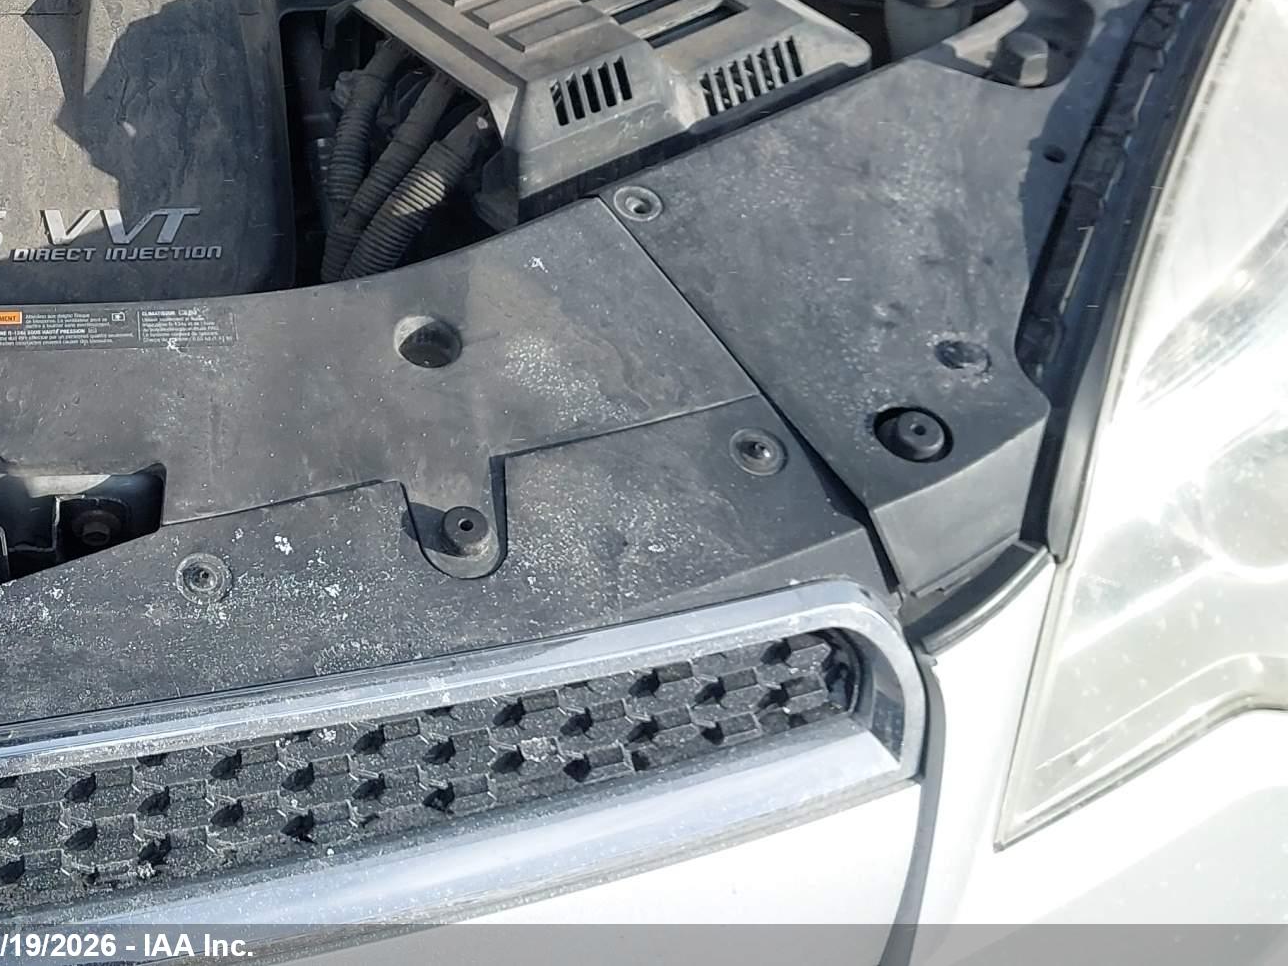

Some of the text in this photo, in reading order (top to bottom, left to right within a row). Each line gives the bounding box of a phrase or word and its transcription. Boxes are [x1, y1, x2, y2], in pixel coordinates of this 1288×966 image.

[41, 208, 200, 245] VVT
[12, 246, 223, 262] DIRECT INJECTION
